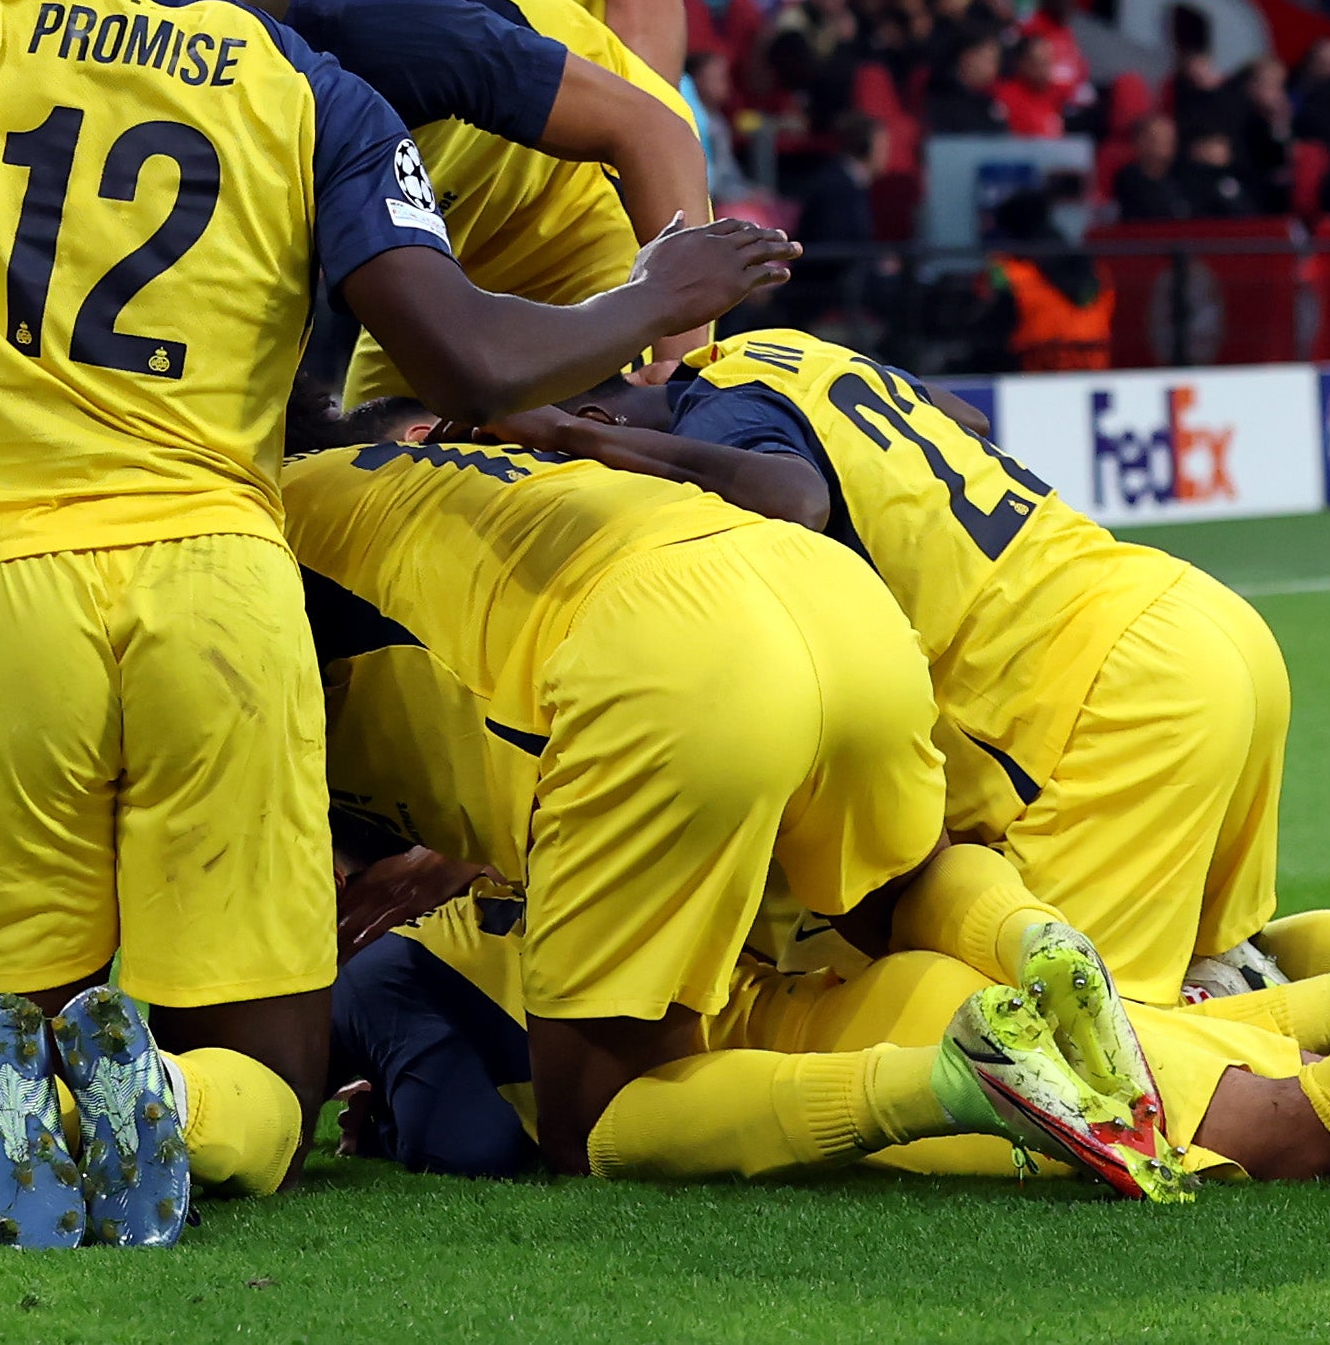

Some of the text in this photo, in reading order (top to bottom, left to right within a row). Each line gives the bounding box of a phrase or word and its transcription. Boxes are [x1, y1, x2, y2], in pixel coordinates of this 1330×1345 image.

[28, 2, 247, 87] PROMISE
[1, 105, 221, 380] 12
[1090, 386, 1238, 509] FedEx
